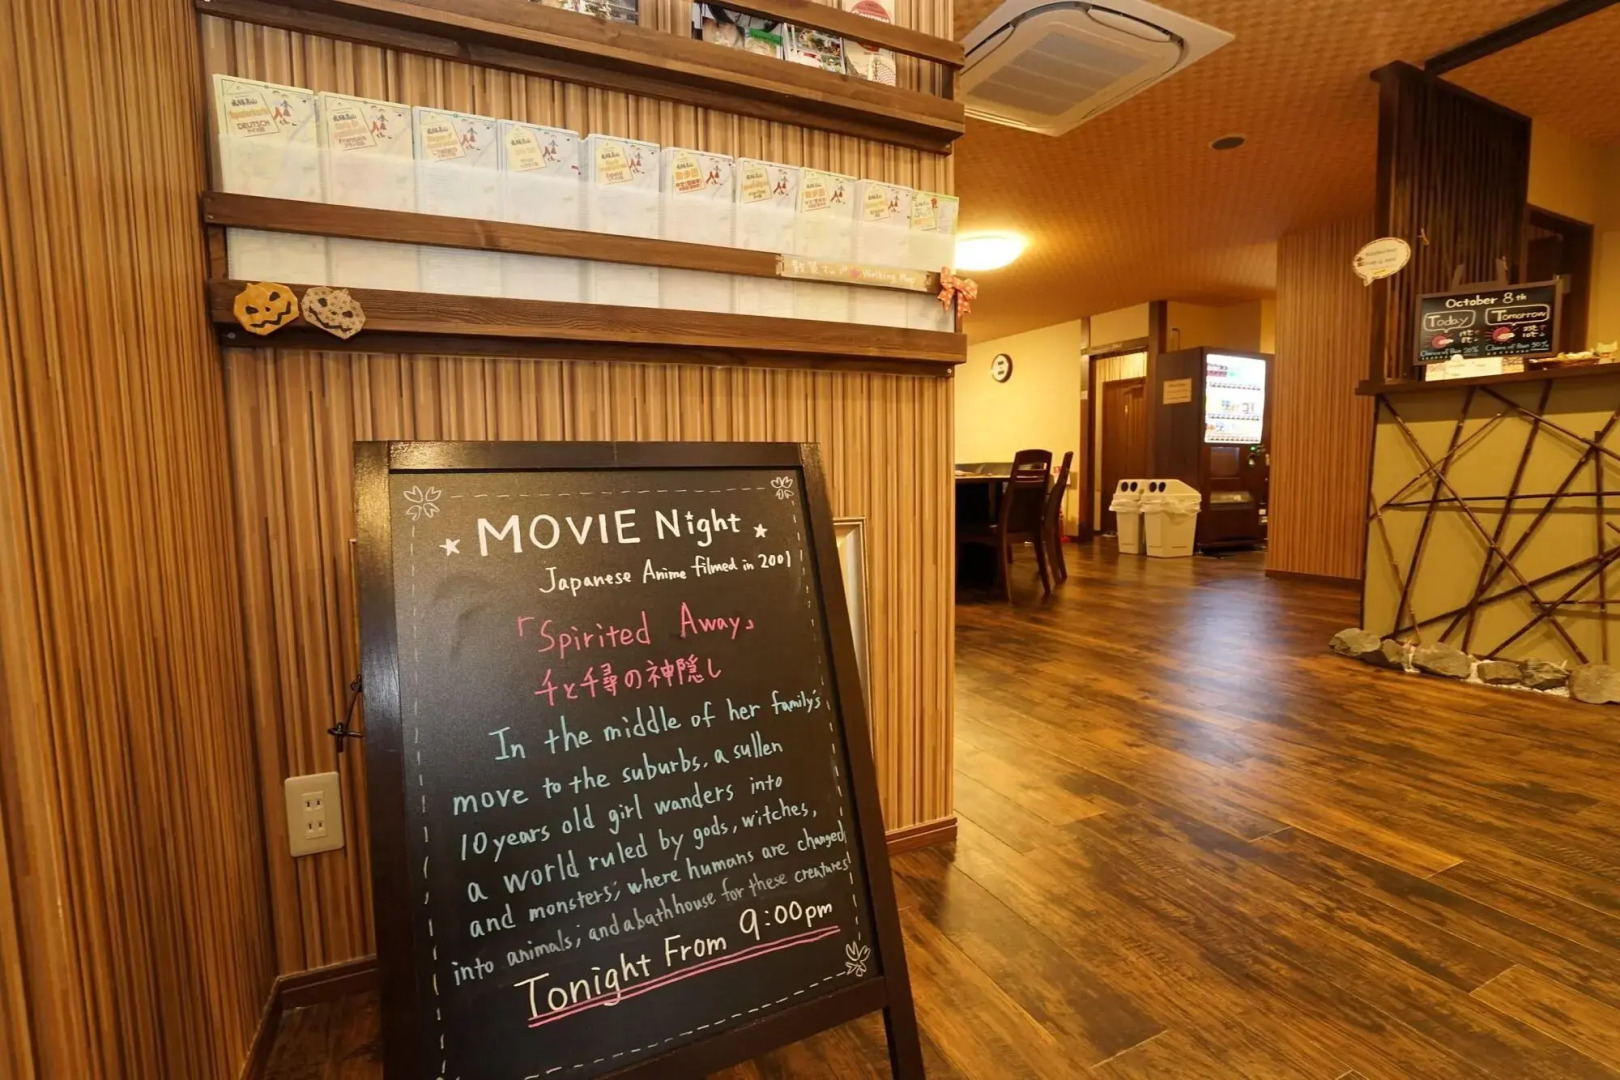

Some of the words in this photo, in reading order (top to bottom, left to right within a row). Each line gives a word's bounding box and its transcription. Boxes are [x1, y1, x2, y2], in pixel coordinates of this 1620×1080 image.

[237, 119, 270, 130] DEUTSCH
[1427, 314, 1469, 329] Today
[1445, 294, 1498, 309] October
[1491, 309, 1547, 322] Tomorrow
[477, 509, 641, 557] MOVIE
[655, 508, 741, 547] Night
[539, 566, 632, 597] Japanese
[642, 558, 687, 584] Anime
[691, 555, 738, 577] filmed
[742, 559, 754, 571] in
[758, 550, 791, 569] 2001
[534, 653, 722, 706] 千と千尋の神隠し
[488, 726, 525, 760] In
[544, 715, 592, 754] the
[603, 705, 681, 742] middle
[691, 701, 715, 728] of
[726, 698, 760, 721] her
[771, 689, 821, 715] family's
[453, 788, 528, 815] move
[542, 777, 561, 799] to
[568, 766, 610, 794] the
[622, 748, 708, 783] suburbs,
[714, 748, 729, 764] a
[734, 731, 783, 760] sullen
[562, 804, 595, 834] old
[609, 793, 643, 835] girl
[654, 782, 734, 815] wanders
[750, 774, 783, 794] into
[468, 881, 488, 902] a
[503, 850, 579, 893] world
[588, 832, 648, 870] ruled
[658, 828, 684, 861] by
[693, 815, 737, 849] gods,
[741, 798, 817, 828] witches,
[470, 903, 516, 938] and
[627, 867, 681, 895] where
[686, 851, 755, 880] humans
[762, 842, 789, 859] are
[797, 820, 845, 851] changed
[451, 957, 494, 985] into
[721, 877, 744, 902] for
[748, 872, 788, 897] these
[513, 953, 651, 1018] Tonight
[664, 934, 726, 967] From
[739, 900, 832, 941] 9:00pm
